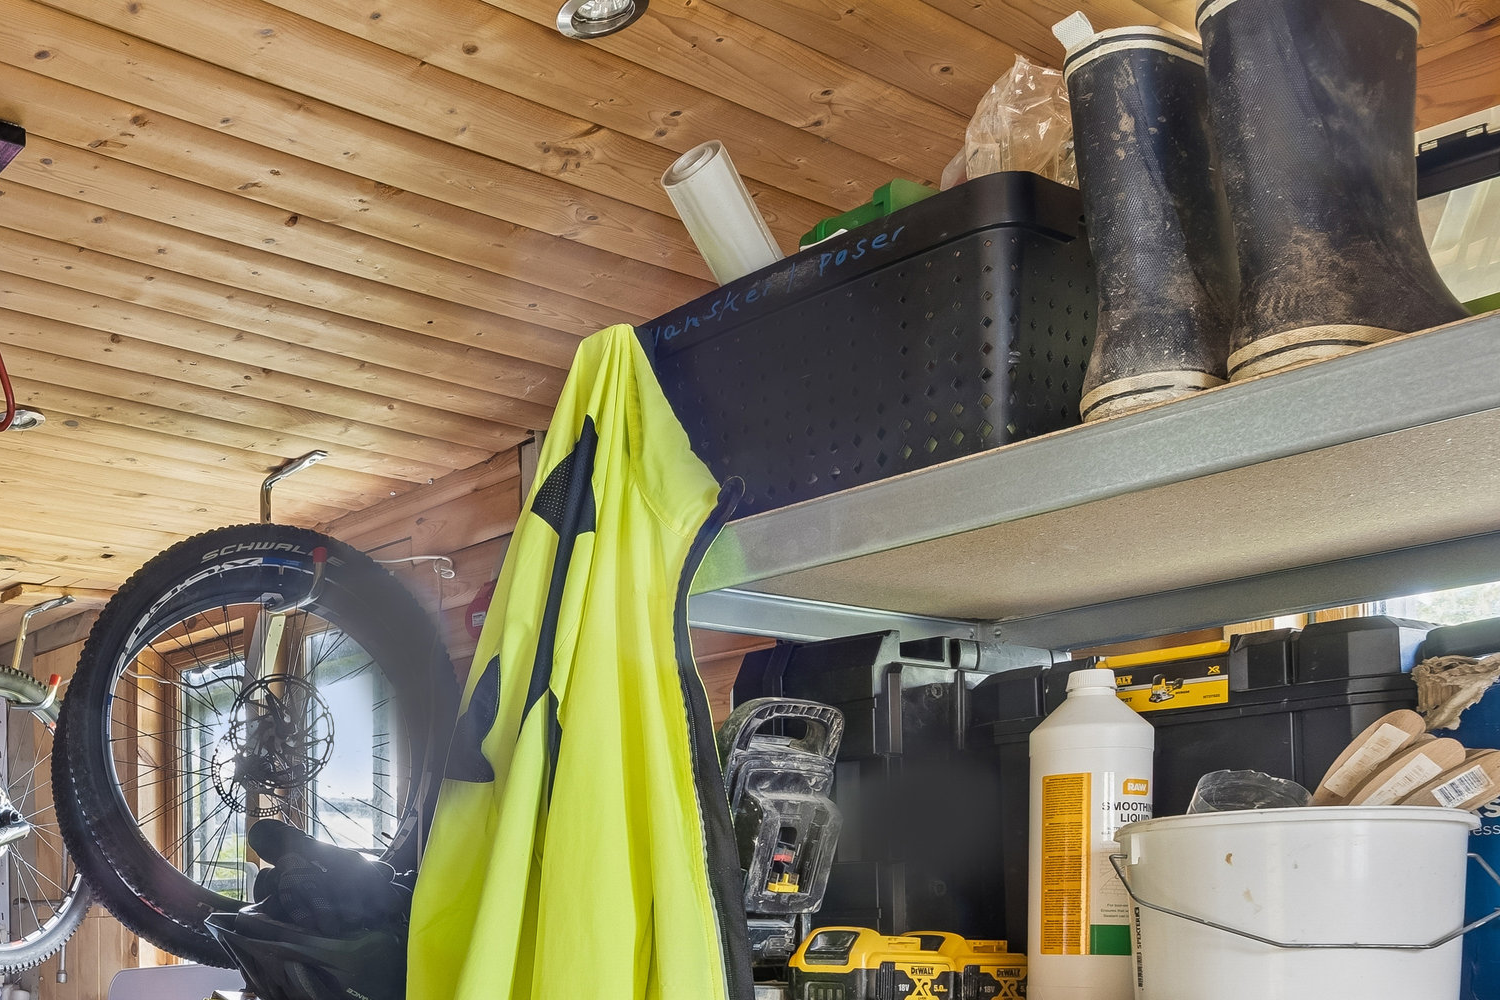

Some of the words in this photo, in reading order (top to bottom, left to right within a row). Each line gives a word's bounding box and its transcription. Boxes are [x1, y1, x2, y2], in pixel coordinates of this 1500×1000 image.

[201, 541, 347, 567] SCHWALE
[1116, 675, 1133, 685] ALT
[1127, 782, 1147, 791] RAW
[1468, 824, 1500, 836] ess
